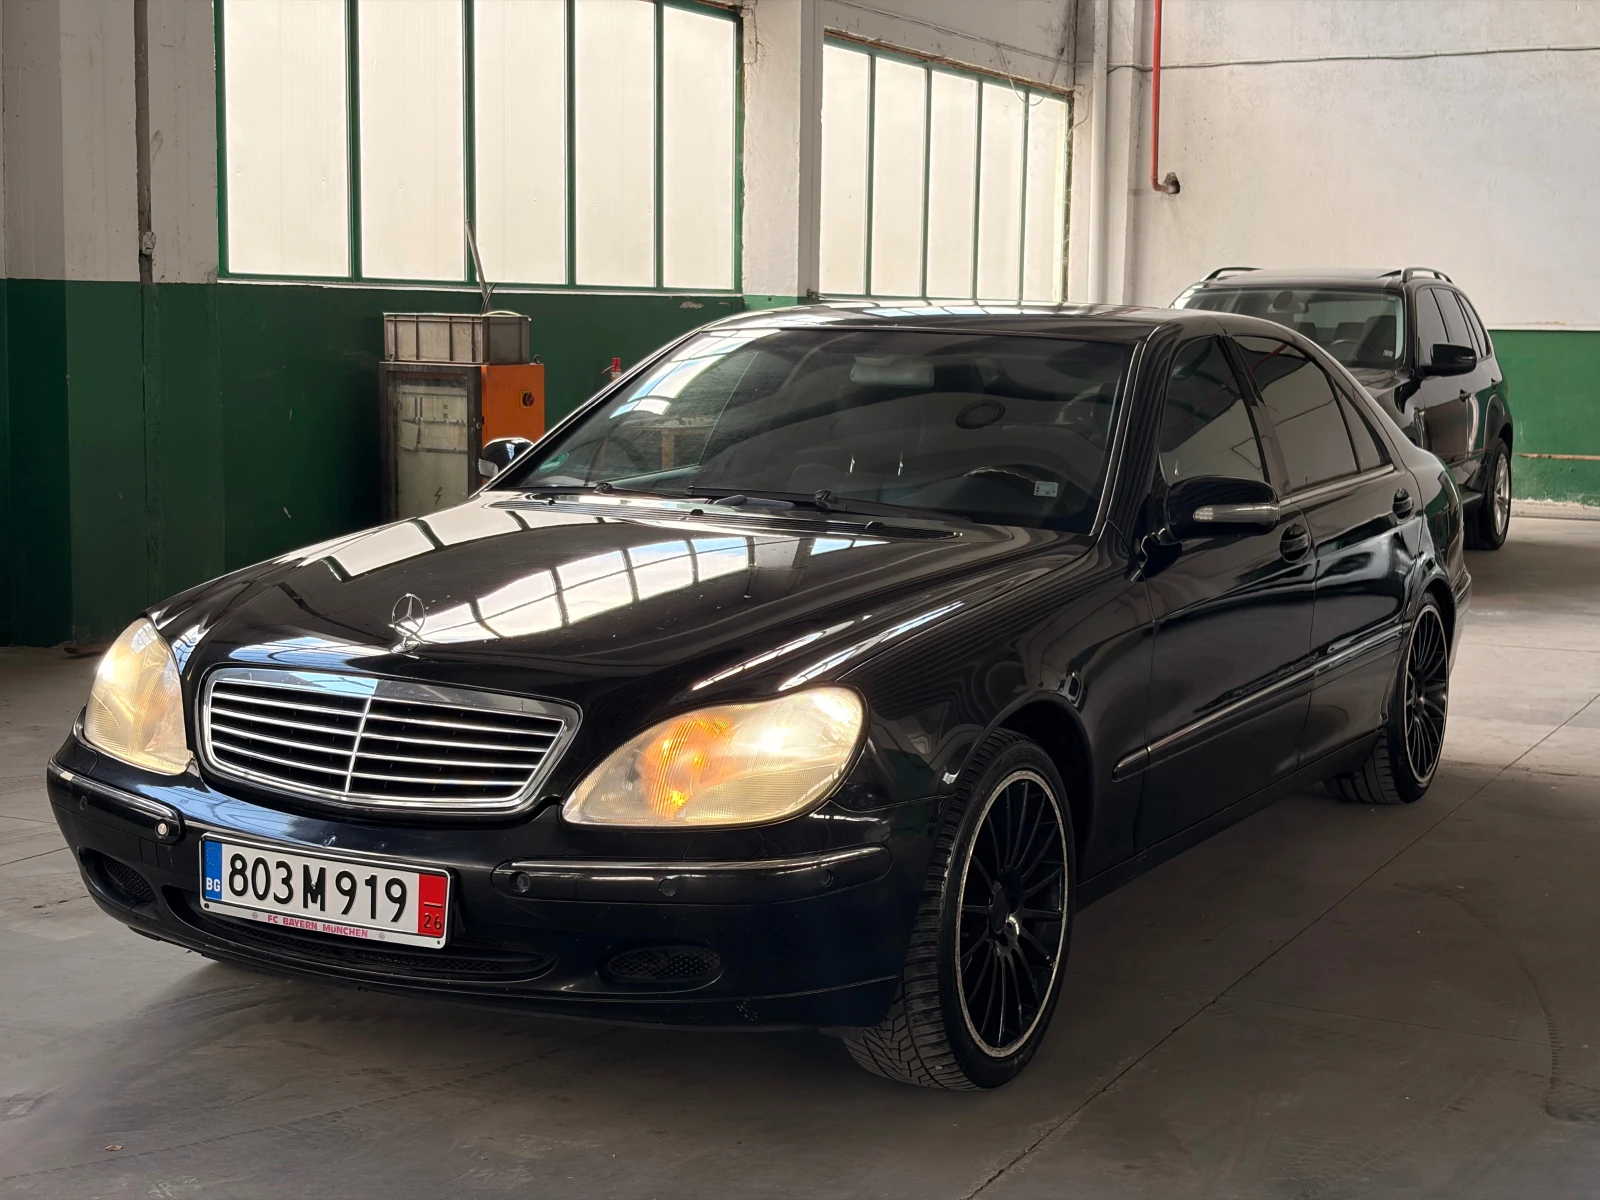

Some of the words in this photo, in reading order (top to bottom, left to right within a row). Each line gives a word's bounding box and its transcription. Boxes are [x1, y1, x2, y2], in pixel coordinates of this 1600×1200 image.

[206, 877, 221, 891] BG
[267, 914, 279, 924] FC
[282, 917, 318, 931] BAYERN
[423, 912, 443, 930] 26
